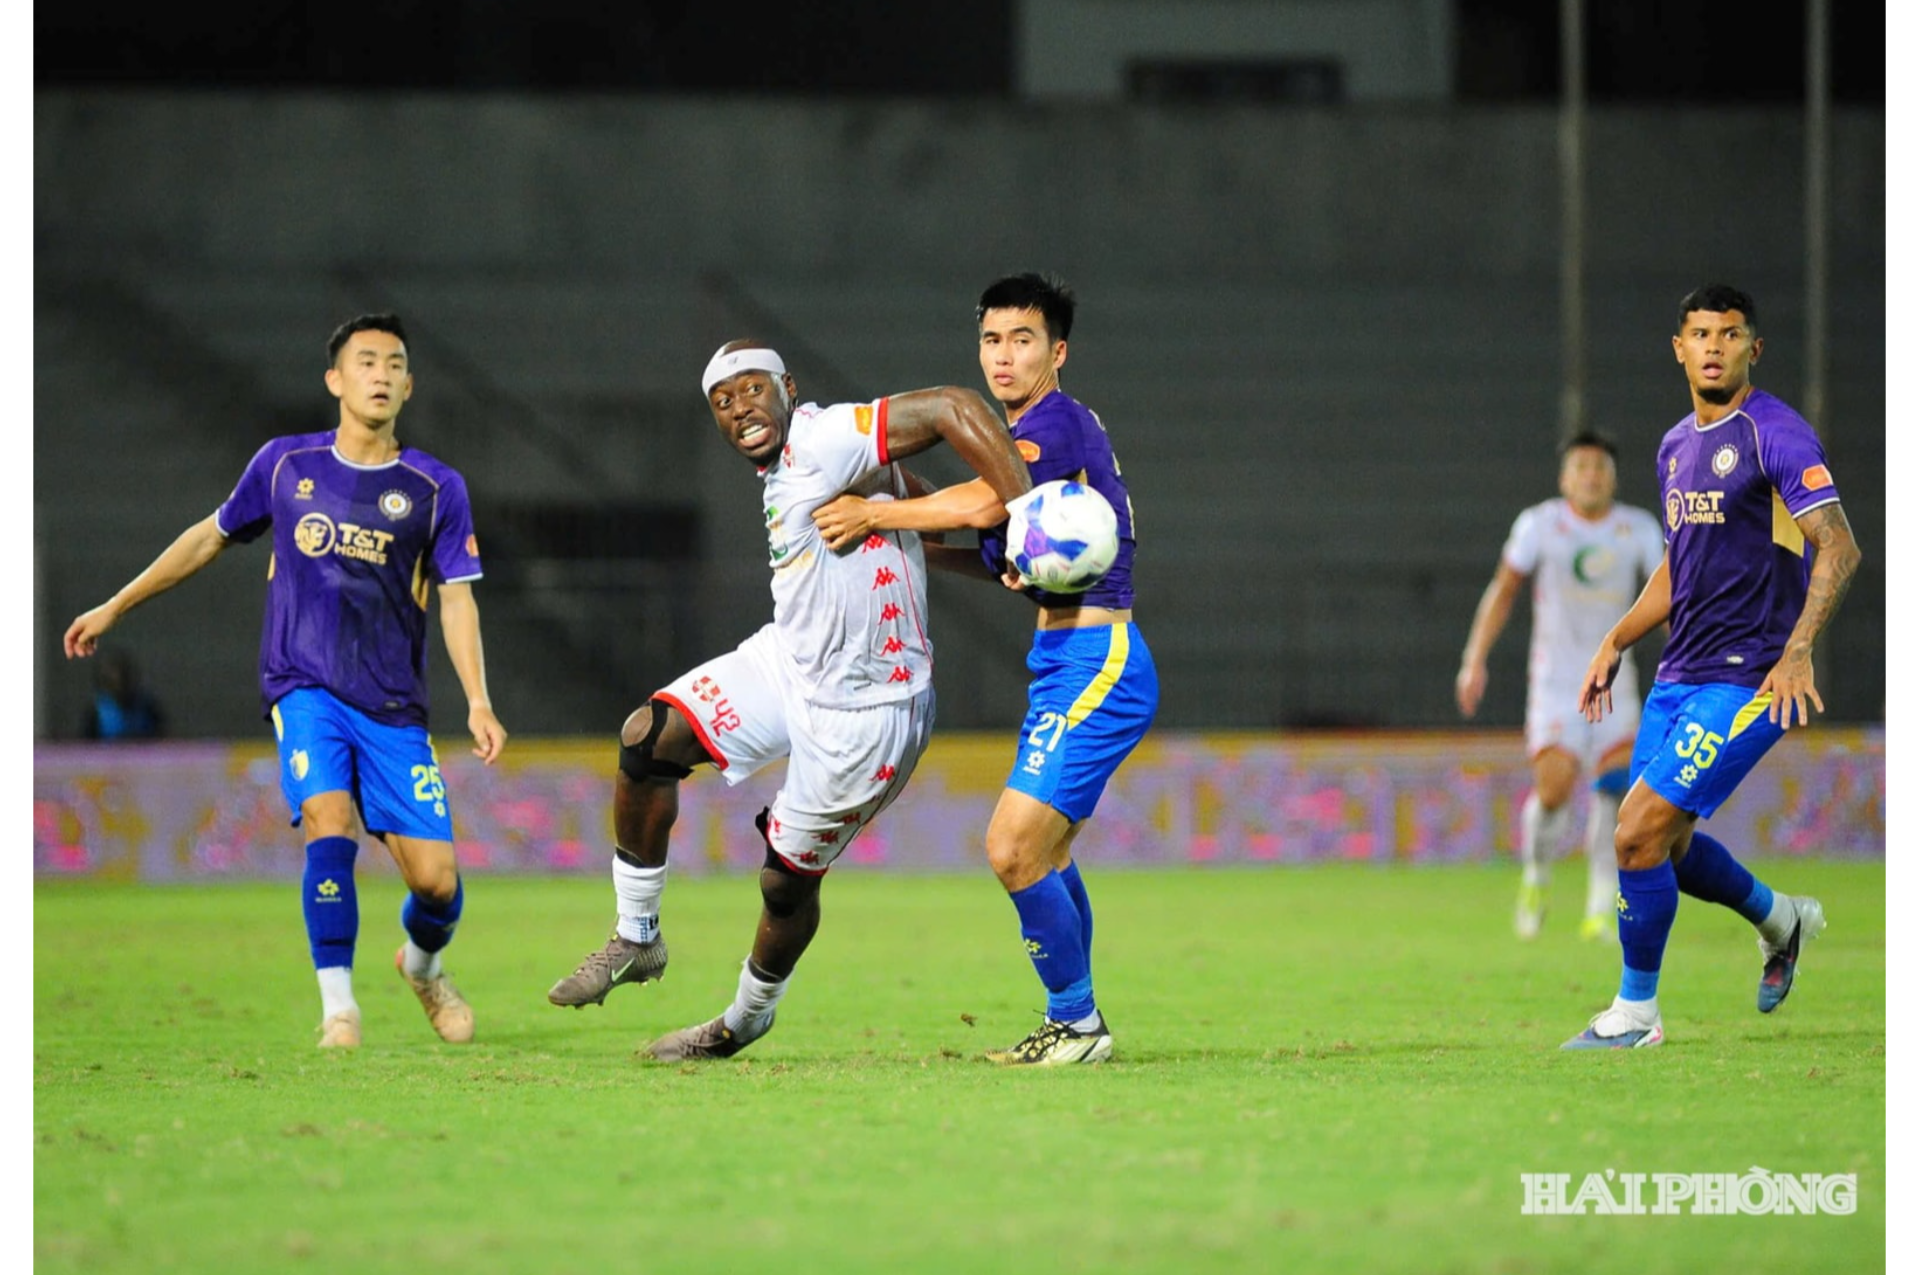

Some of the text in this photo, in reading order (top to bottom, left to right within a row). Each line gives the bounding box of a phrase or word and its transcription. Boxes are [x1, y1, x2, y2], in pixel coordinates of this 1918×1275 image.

[1685, 491, 1725, 512] T&T
[1684, 512, 1726, 524] HOMES
[338, 523, 394, 551] T&T
[334, 543, 388, 566] HOMES
[709, 698, 741, 737] 42
[1028, 712, 1067, 752] 21
[1675, 722, 1724, 769] 35
[411, 764, 446, 801] 25
